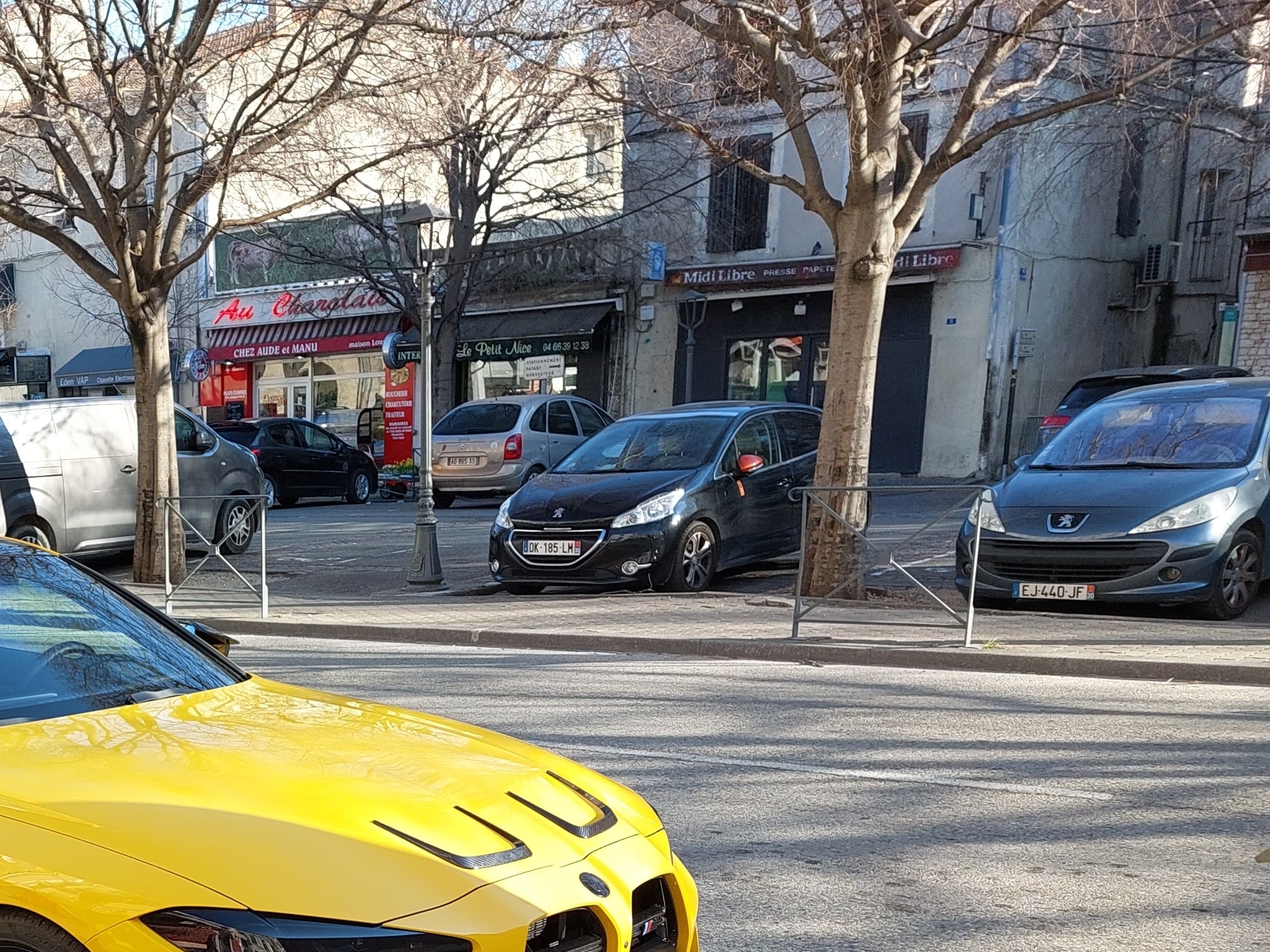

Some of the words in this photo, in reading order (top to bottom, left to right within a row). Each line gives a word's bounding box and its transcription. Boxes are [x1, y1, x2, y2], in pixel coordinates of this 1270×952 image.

[913, 253, 954, 267] Libre
[683, 270, 716, 284] Midi
[718, 268, 755, 282] Libre
[763, 267, 797, 276] PRESSE
[214, 298, 254, 324] Au
[233, 347, 255, 358] CHEZ
[257, 345, 280, 356] AUDE
[281, 345, 290, 354] et
[292, 342, 318, 353] MANU
[349, 340, 371, 348] maison
[456, 342, 472, 357] Le
[475, 341, 502, 356] Petit
[505, 340, 532, 355] Nice
[59, 378, 75, 386] Eden
[76, 376, 89, 385] VAP
